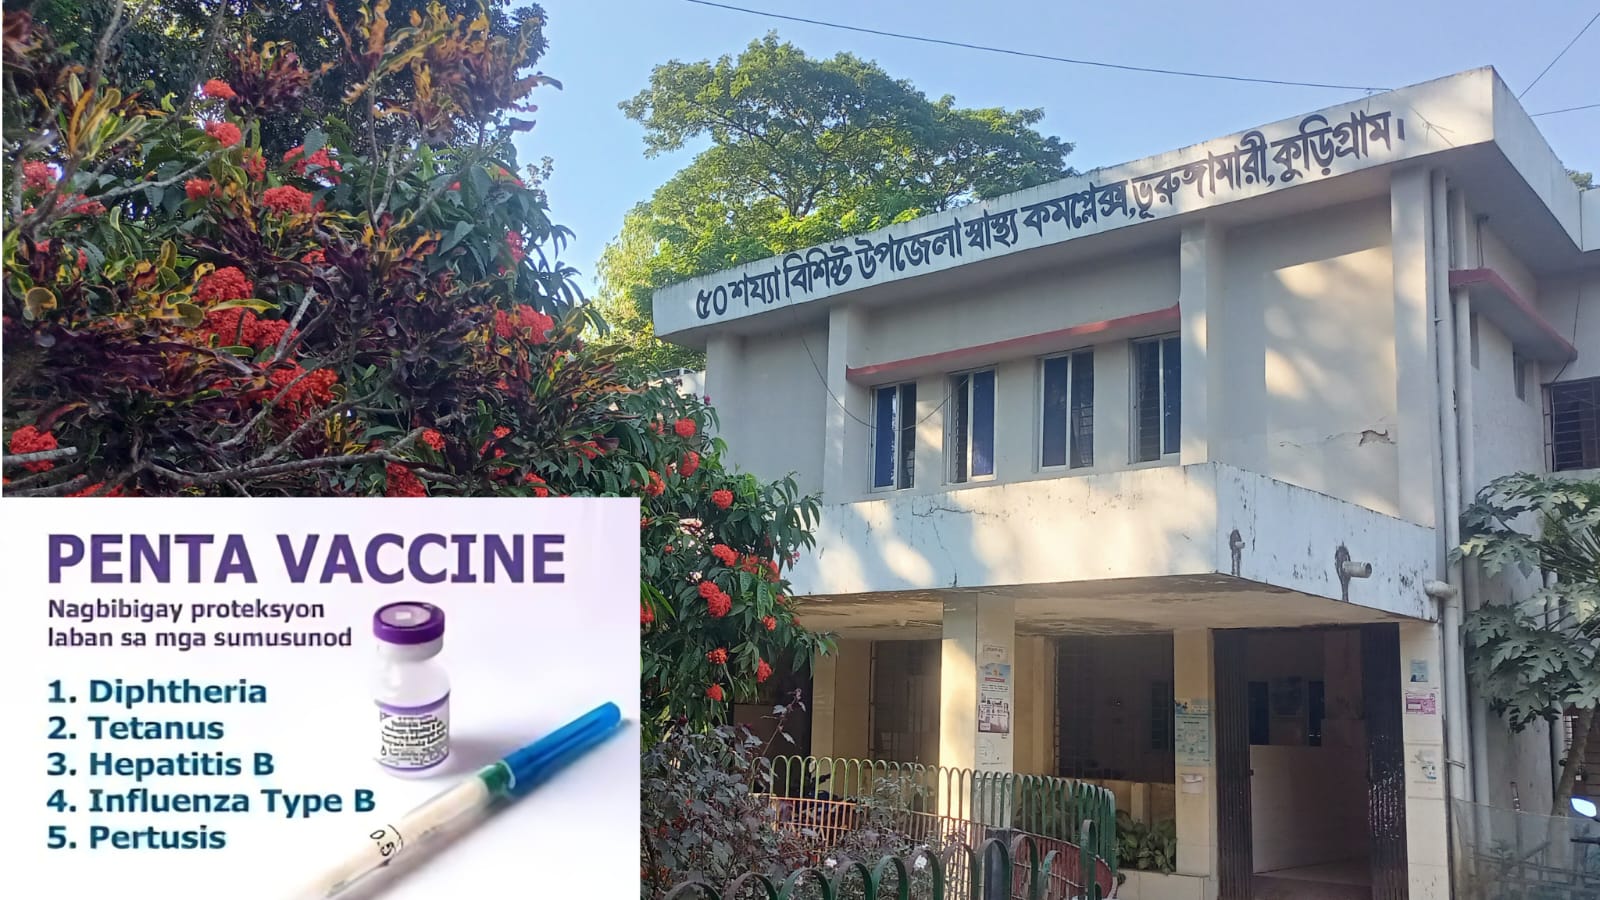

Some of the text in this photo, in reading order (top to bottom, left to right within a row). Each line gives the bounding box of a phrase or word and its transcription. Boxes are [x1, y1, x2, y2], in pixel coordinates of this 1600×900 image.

[695, 285, 728, 320] ৫০
[730, 265, 781, 308] শয্যা
[782, 245, 853, 299] বিশিষ্ট
[854, 216, 963, 280] উপজেলা
[963, 208, 1019, 249] স্বাস্থ্য
